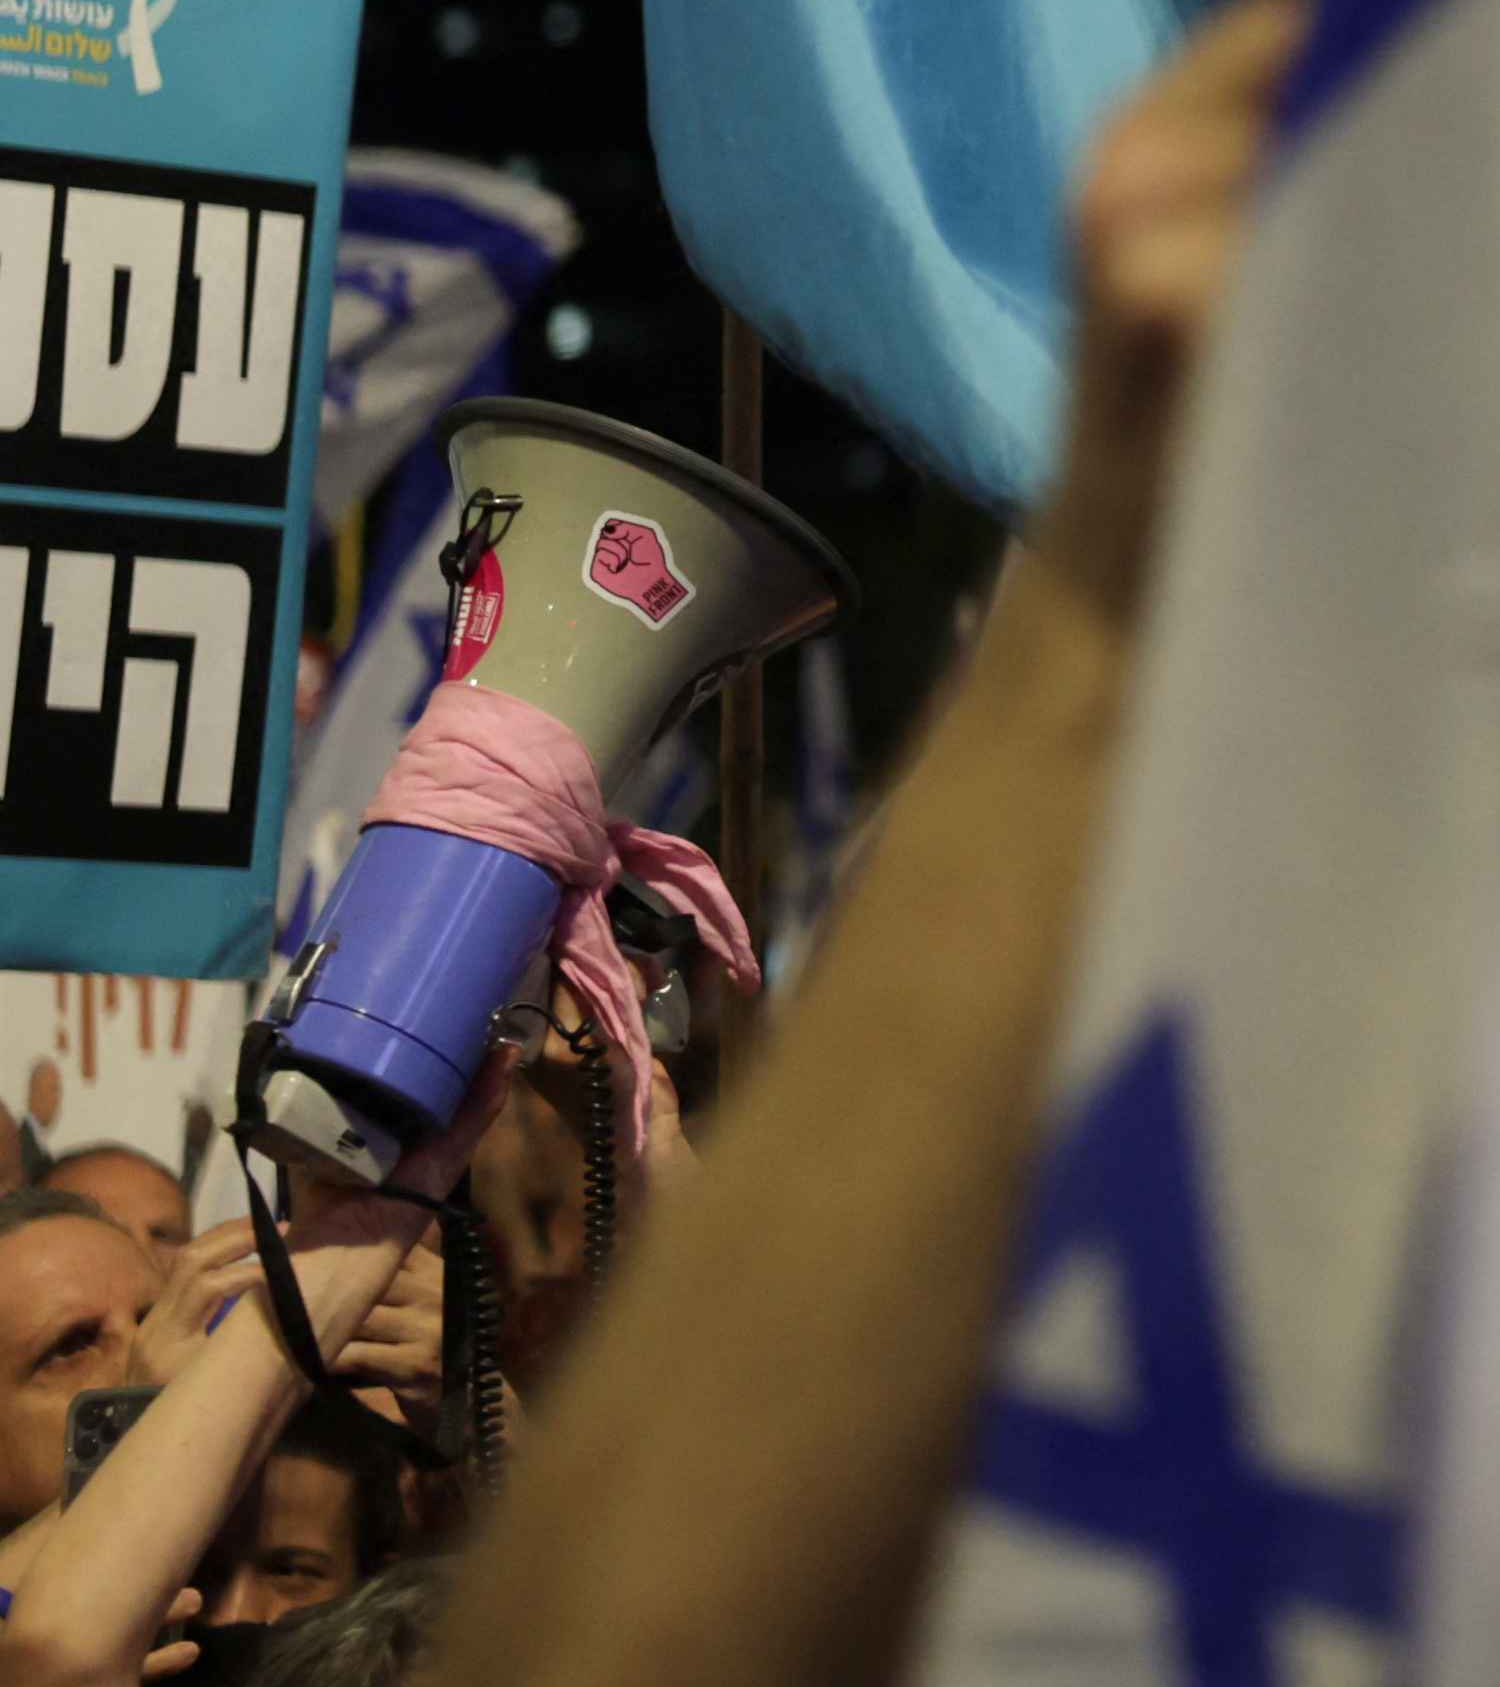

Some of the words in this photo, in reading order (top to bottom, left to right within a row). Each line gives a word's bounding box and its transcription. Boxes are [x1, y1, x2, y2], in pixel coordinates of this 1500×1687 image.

[46, 30, 112, 64] שלום
[642, 577, 669, 603] PINK
[648, 584, 683, 616] FRONT
